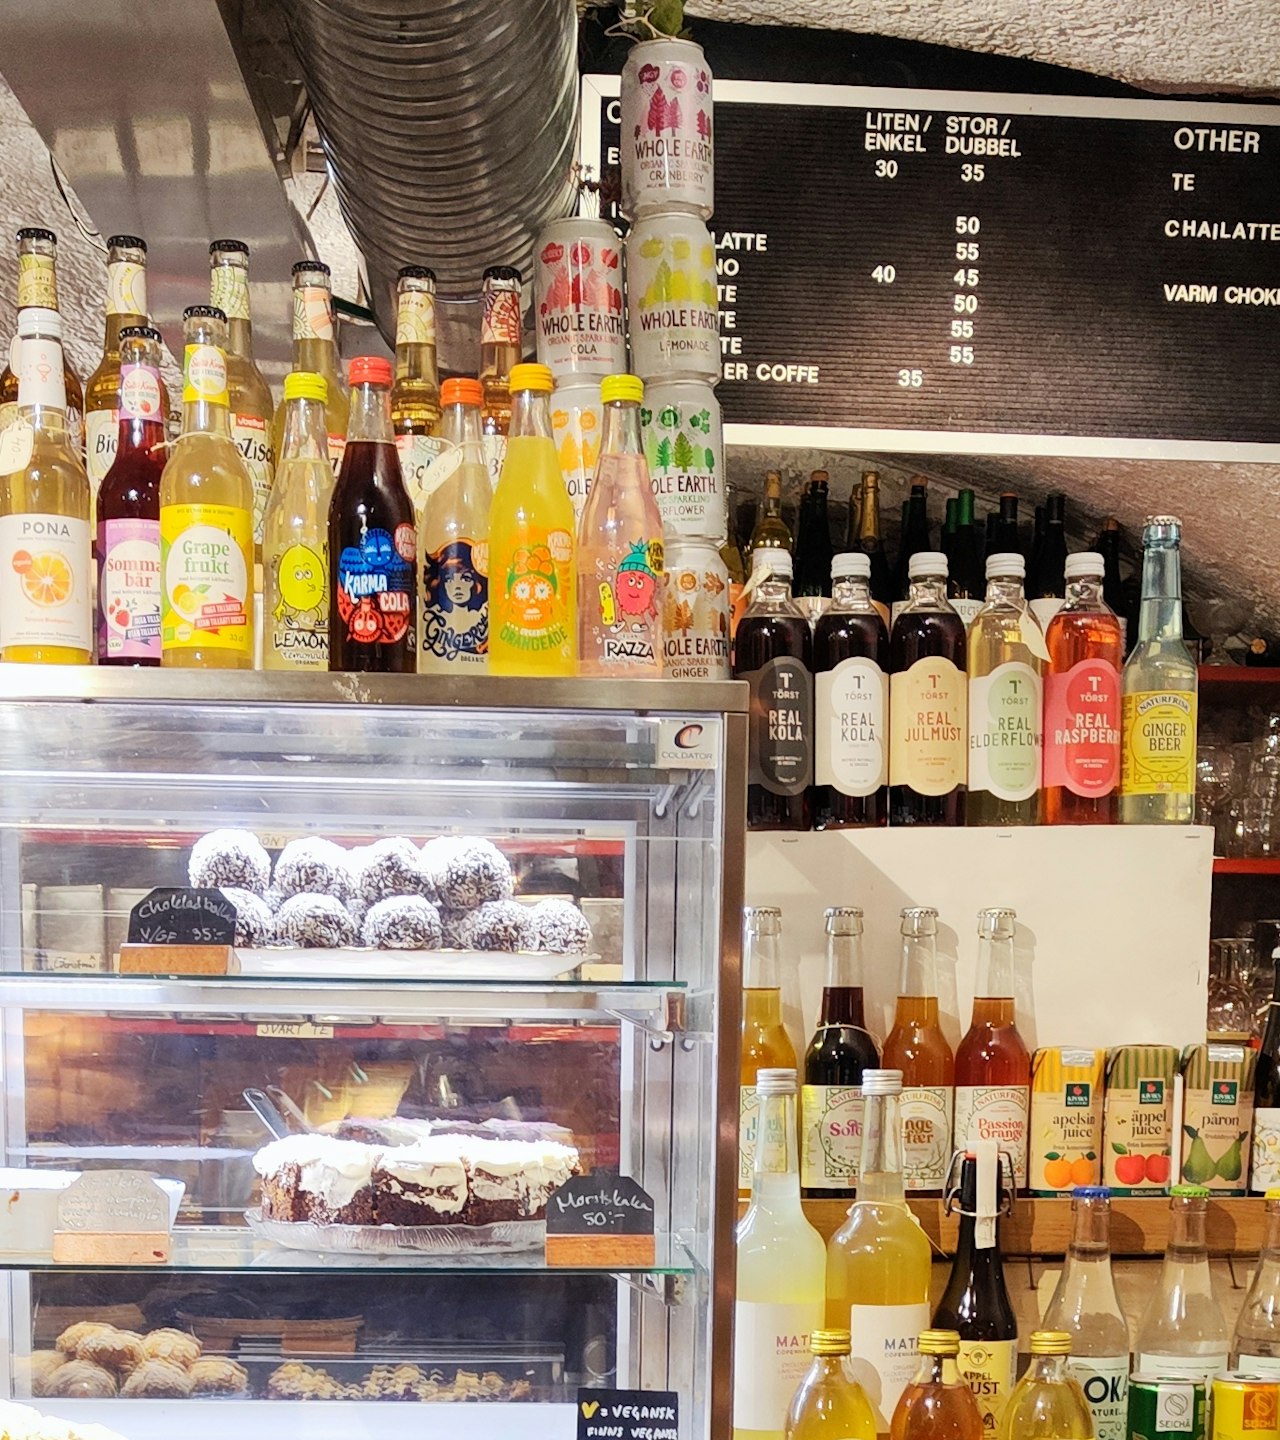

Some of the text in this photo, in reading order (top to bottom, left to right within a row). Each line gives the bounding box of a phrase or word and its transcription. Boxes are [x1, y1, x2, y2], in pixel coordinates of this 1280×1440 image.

[864, 132, 1021, 157] ENKEL DUBBEL
[1173, 128, 1260, 154] OTHER
[635, 139, 681, 160] WHOLE
[649, 170, 704, 184] CRANBERRY
[875, 160, 984, 182] 30 35
[1172, 173, 1195, 191] TE
[955, 217, 980, 235] 50
[956, 243, 979, 261] 55
[872, 266, 979, 286] 40 45
[1164, 285, 1218, 303] VARM
[954, 295, 978, 313] 50
[542, 314, 623, 336] WHOLE EARTH
[640, 310, 687, 331] WHOLE
[951, 321, 973, 338] 55
[570, 344, 597, 355] COLA
[659, 340, 710, 352] LEMONADE
[950, 347, 974, 364] 55
[756, 364, 819, 384] COFFE
[899, 370, 922, 387] 35
[678, 475, 717, 494] EARTH
[22, 522, 70, 537] PONA
[182, 540, 230, 558] Grape
[184, 557, 229, 575] frukt
[124, 570, 152, 588] bär
[344, 572, 387, 604] KARMA
[380, 592, 410, 613] COLA
[696, 638, 727, 657] EARTH
[672, 667, 709, 678] GINGER
[773, 688, 799, 700] TÖRST
[845, 689, 872, 701] TÖRST
[921, 689, 948, 700] TÖRST
[1001, 693, 1028, 705] TÖRST
[1080, 691, 1108, 703] TÖRST
[1138, 694, 1190, 713] NATURFRISK
[768, 710, 801, 726] REAL
[841, 713, 875, 728] REAL
[917, 712, 951, 727] REAL
[998, 717, 1032, 732] REAL
[1075, 714, 1110, 729] REAL
[768, 725, 803, 742] KOLA
[841, 726, 876, 742] KOLA
[904, 725, 962, 743] JULMUST
[1143, 723, 1187, 738] GINGER
[1149, 736, 1181, 751] BEER
[978, 1117, 1024, 1131] Passion
[1052, 1112, 1095, 1125] apelsin
[1131, 1109, 1167, 1123] äppel
[1201, 1113, 1239, 1128] päron
[1063, 1124, 1093, 1139] juice
[1131, 1123, 1162, 1138] juice
[612, 1405, 675, 1420] VEGANSK
[587, 1427, 624, 1437] FINNS
